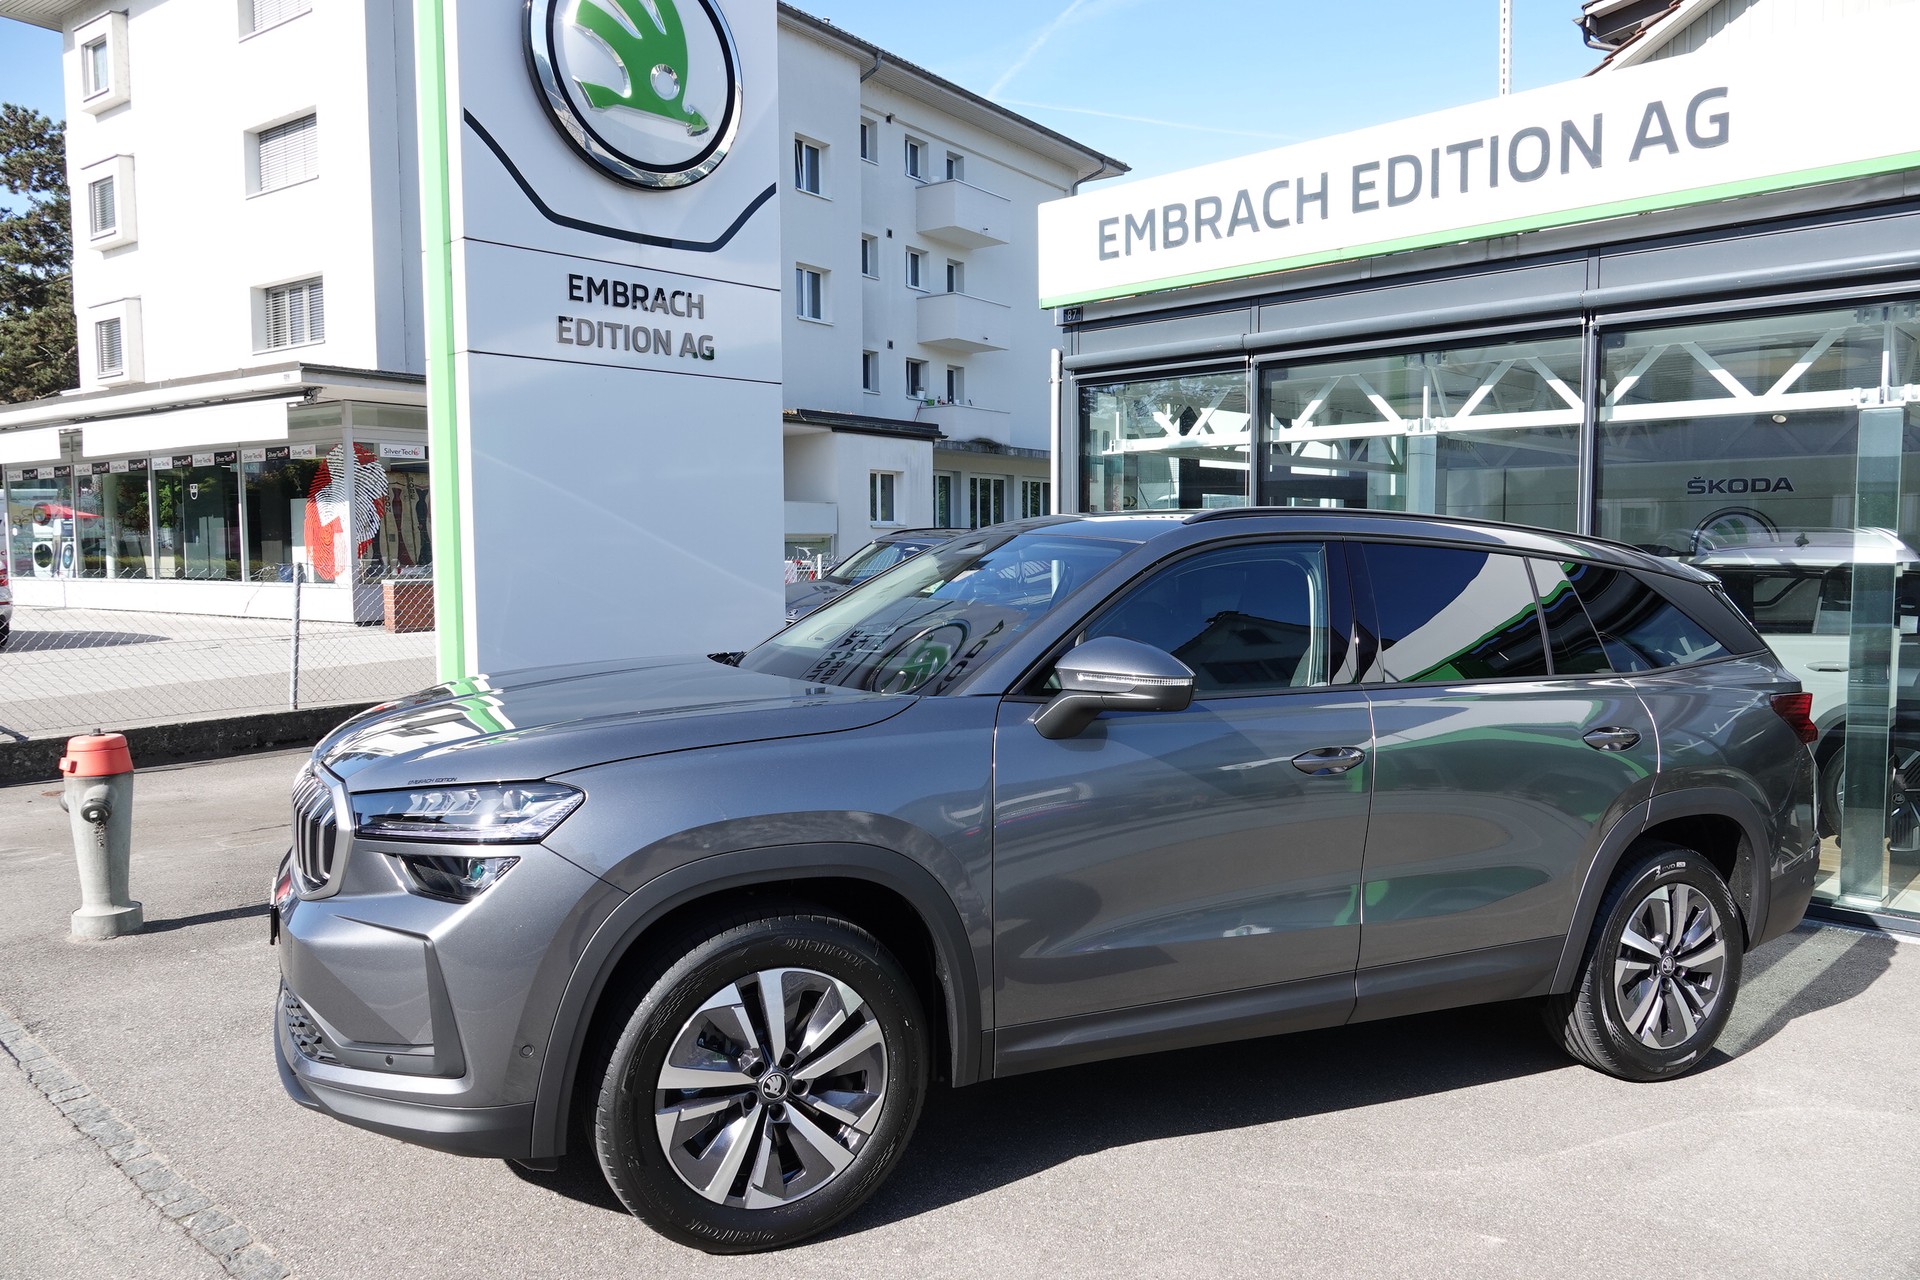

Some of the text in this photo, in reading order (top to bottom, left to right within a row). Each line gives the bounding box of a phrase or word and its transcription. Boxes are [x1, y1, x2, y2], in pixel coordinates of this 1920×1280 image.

[1099, 86, 1731, 261] EMBRACH EDITION AG
[568, 273, 705, 320] EMBRACH
[1067, 309, 1078, 321] 87
[557, 315, 715, 361] EDITION AG
[1687, 476, 1795, 495] ŠKODA
